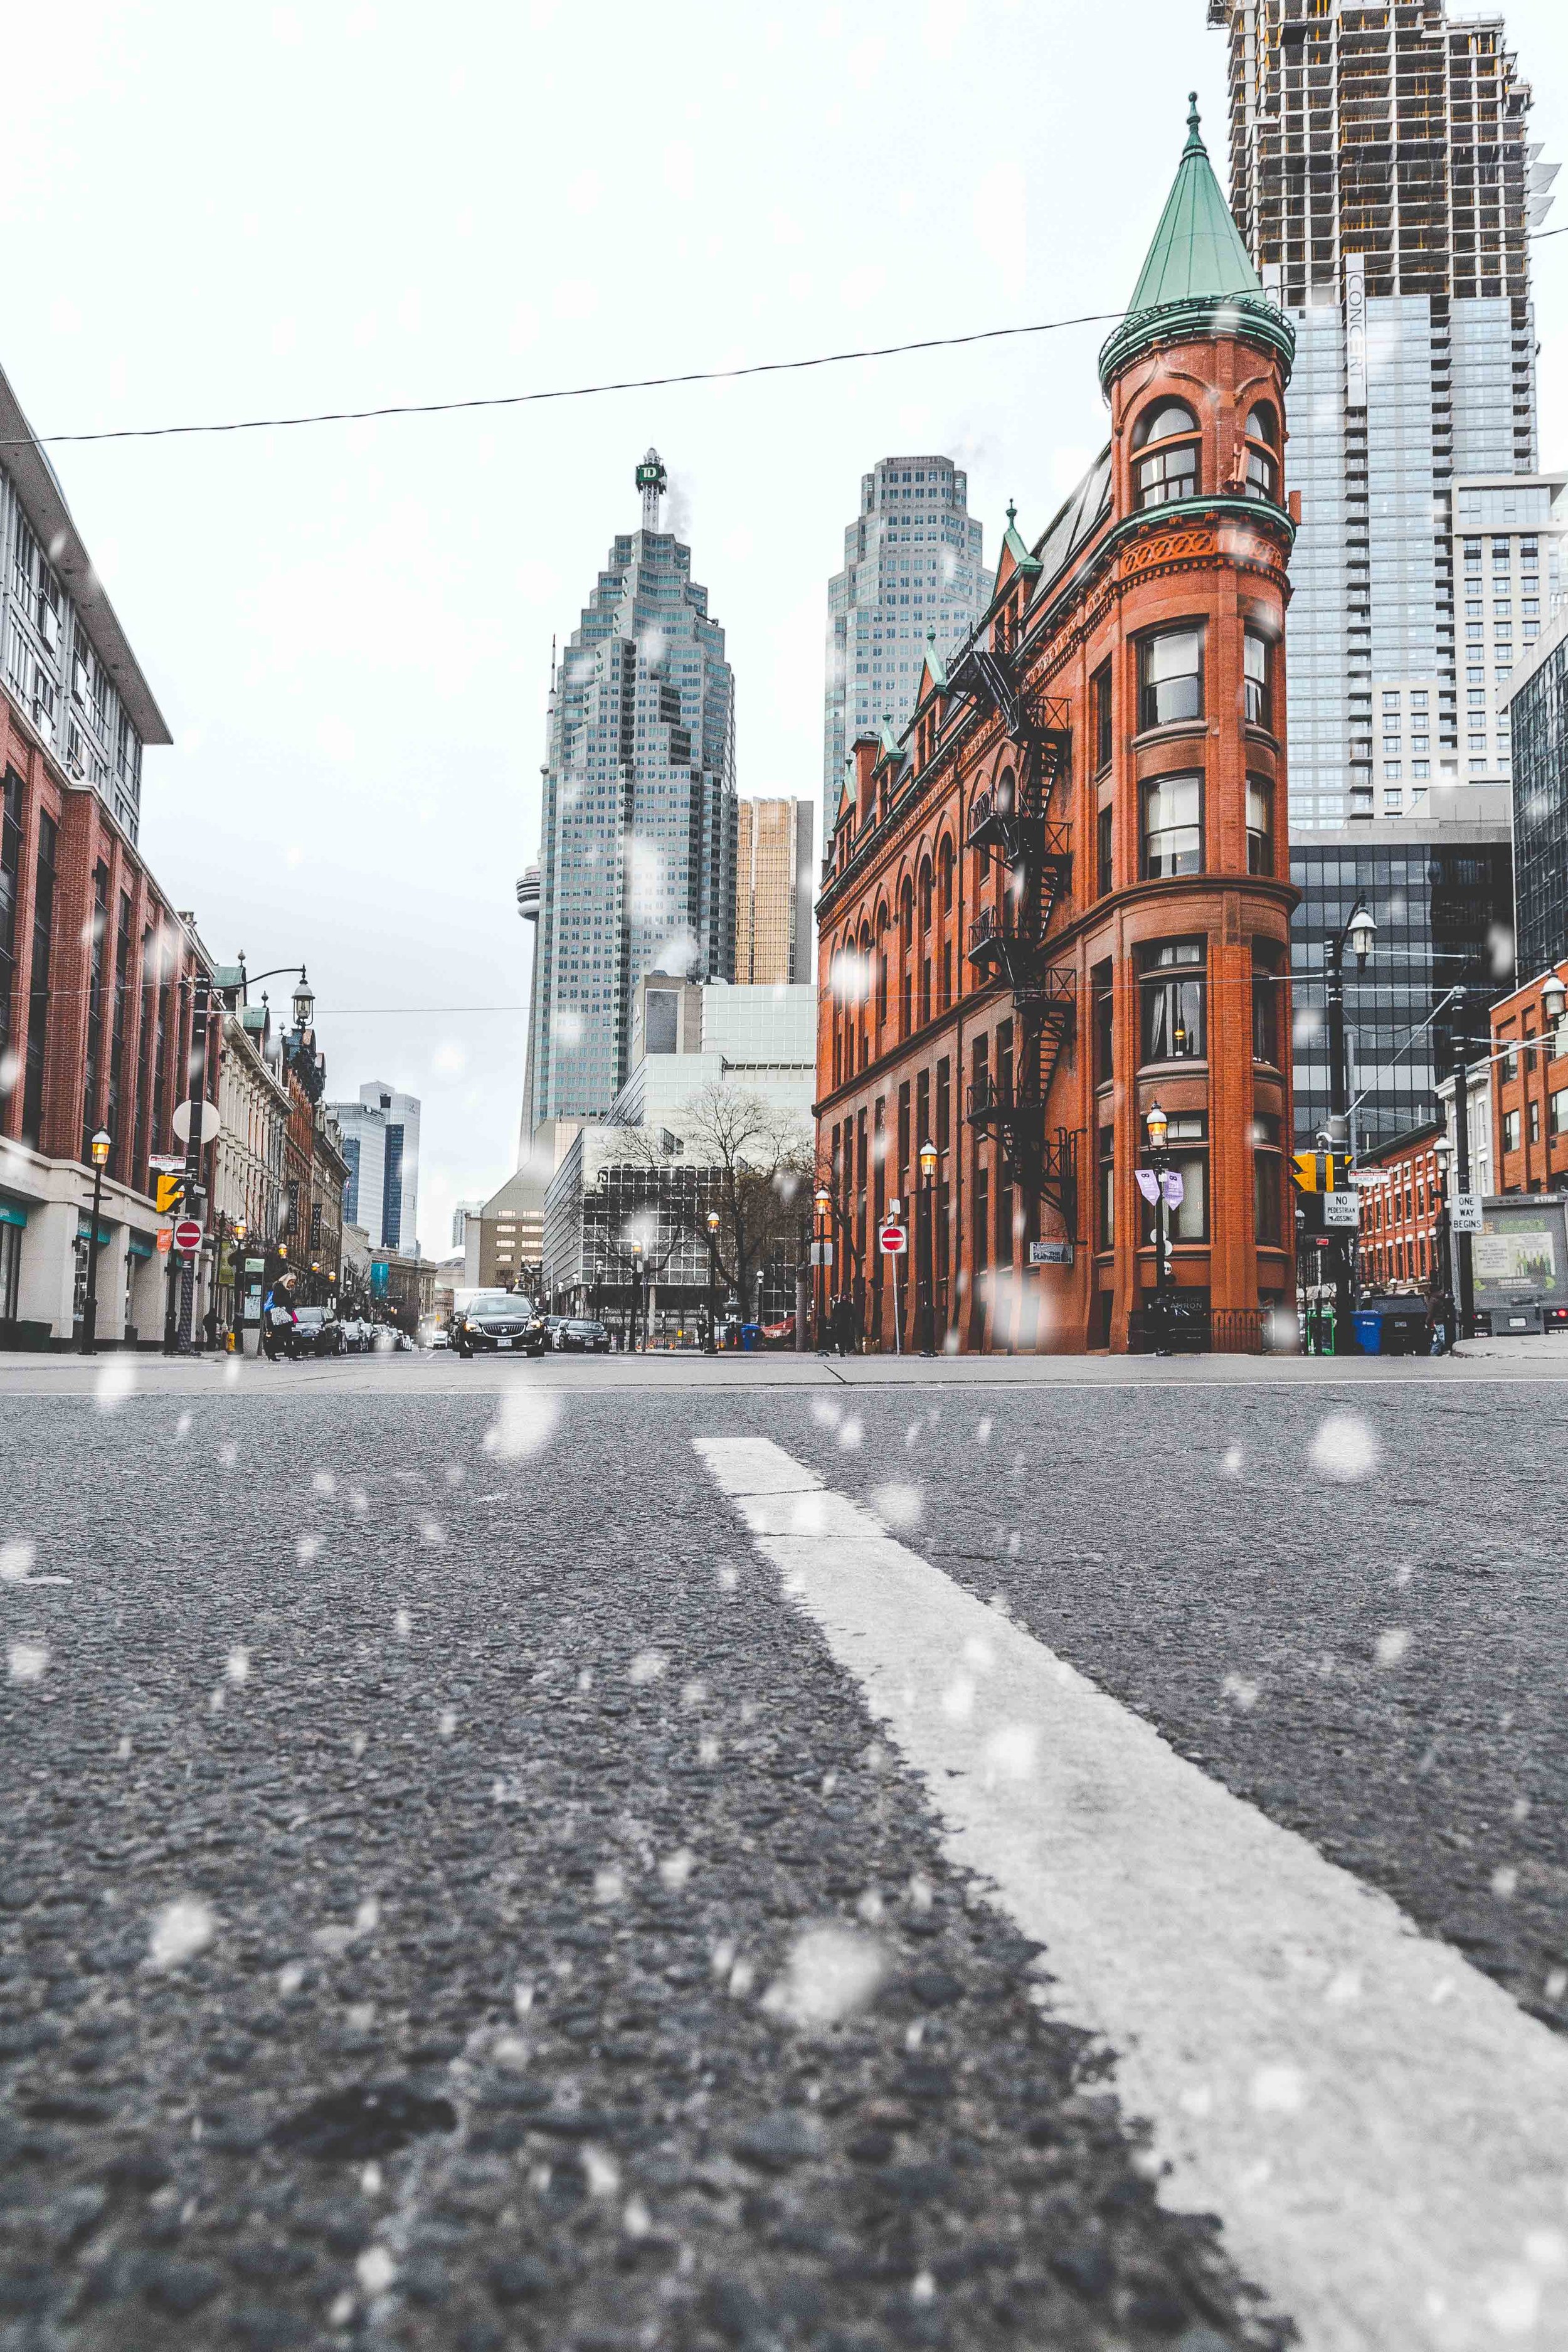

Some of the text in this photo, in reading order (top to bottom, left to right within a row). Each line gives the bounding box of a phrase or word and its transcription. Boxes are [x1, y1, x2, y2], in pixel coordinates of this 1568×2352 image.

[1349, 275, 1364, 381] CONCERT
[641, 467, 657, 478] TD
[289, 1184, 299, 1231] WINNERS
[1336, 1196, 1347, 1205] NO
[313, 1207, 322, 1247] WINNERS
[1453, 1220, 1481, 1228] BEGINS
